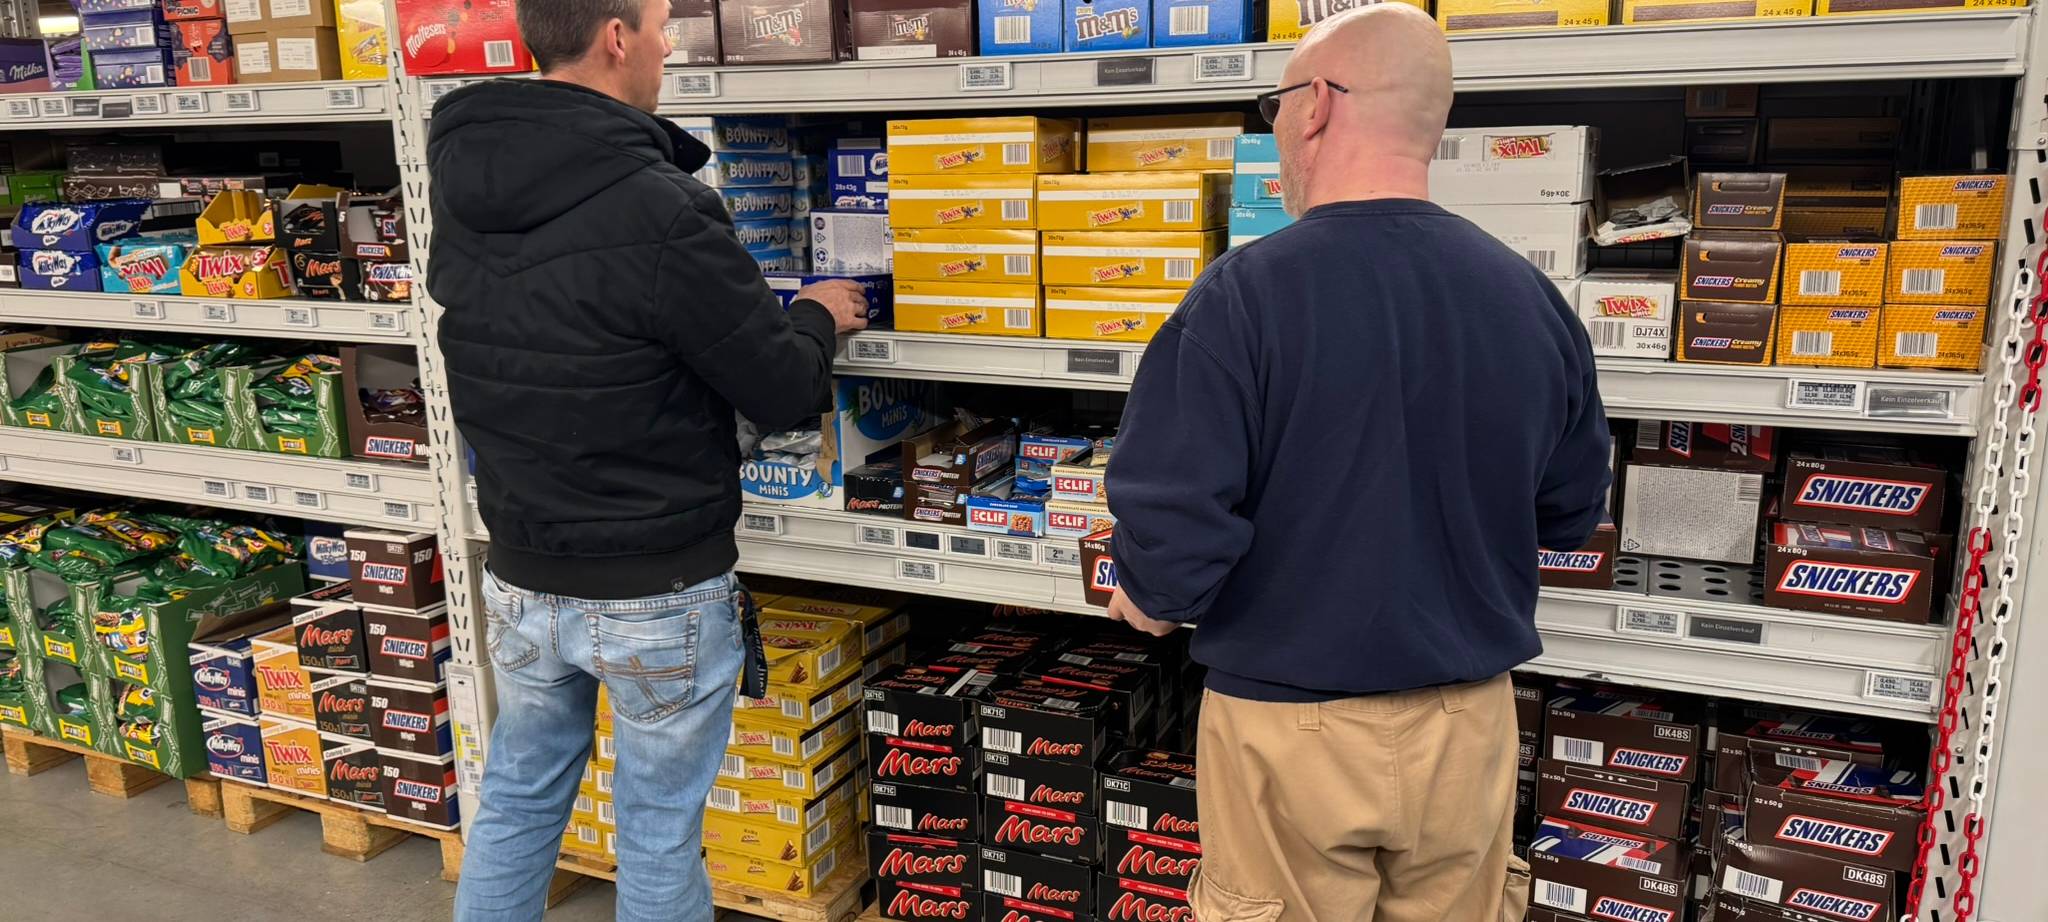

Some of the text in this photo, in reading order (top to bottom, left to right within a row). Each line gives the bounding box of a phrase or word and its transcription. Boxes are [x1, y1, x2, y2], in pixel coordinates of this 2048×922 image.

[177, 5, 199, 16] PICNIC
[1796, 9, 1802, 17] g
[405, 23, 446, 58] Maltesers
[10, 61, 44, 79] Milka
[726, 127, 773, 143] BOUNTY
[730, 161, 776, 179] BOUNTY
[1954, 180, 1995, 190] SNICKERS
[735, 196, 777, 211] BOUNTY
[1709, 205, 1774, 214] SNICKERS Creamy
[736, 229, 776, 245] OUNTY
[1838, 248, 1877, 258] SNICKERS
[1941, 246, 1983, 255] SNICKERS
[306, 260, 341, 278] Mars
[1695, 277, 1765, 286] SNICKERS Creamy
[1830, 310, 1868, 319] SNICKERS
[1935, 310, 1975, 319] SNICKERS
[1635, 327, 1665, 337] DJ74X
[1692, 338, 1762, 348] SNICKERS Creamy
[1031, 447, 1056, 458] CLIF
[914, 470, 960, 480] SNICKERS PROTEIN
[1062, 480, 1091, 491] CLIF
[1804, 478, 1923, 511] SNICKERS
[916, 509, 962, 519] SNICKERS PROTEIN
[978, 510, 1005, 523] CLIF
[1056, 514, 1085, 527] CLIF
[350, 551, 367, 562] 150
[413, 549, 433, 564] 150
[364, 564, 405, 583] SNICKERS
[1785, 565, 1910, 598] SNICKERS
[301, 624, 353, 646] Mars
[369, 623, 386, 636] 150
[1715, 624, 1755, 634] Einzelverkauf
[384, 640, 425, 657] SNICKERS
[227, 687, 246, 697] minis
[287, 691, 312, 701] minis
[318, 692, 364, 713] Mars
[371, 696, 388, 709] 150
[982, 706, 1004, 717] DK71C
[385, 713, 428, 730] SNICKERS
[903, 719, 954, 737] Mars
[1658, 727, 1690, 740] DK48S
[1027, 737, 1083, 756] Mars
[240, 754, 260, 765] minis
[878, 748, 961, 777] Mars
[986, 753, 1007, 765] DK71C
[1615, 751, 1683, 772] SNICKERS
[296, 766, 321, 776] minis
[330, 760, 379, 781] Mars
[383, 766, 400, 779] 150
[396, 782, 439, 800] SNICKERS
[875, 786, 895, 794] DK71C
[1106, 779, 1129, 791] DK71C
[1806, 781, 1872, 794] SNICKERS
[1030, 784, 1084, 804] Mars
[1567, 791, 1651, 822] SNICKERS
[918, 812, 968, 831] Mars
[1153, 812, 1199, 833] Mar
[995, 815, 1085, 845] Mars
[1784, 819, 1886, 852] SNICKERS
[1582, 832, 1643, 848] SNICKERS
[879, 848, 967, 877] Mars
[984, 849, 1004, 861] DK71C
[1117, 845, 1201, 875] Mar
[1848, 869, 1883, 885] DK48S
[1027, 882, 1081, 903] Mars
[1643, 879, 1676, 895] DK48S
[888, 889, 970, 919] Mars
[1597, 900, 1669, 922] SNICKERS
[1793, 891, 1873, 919] SNICKERS
